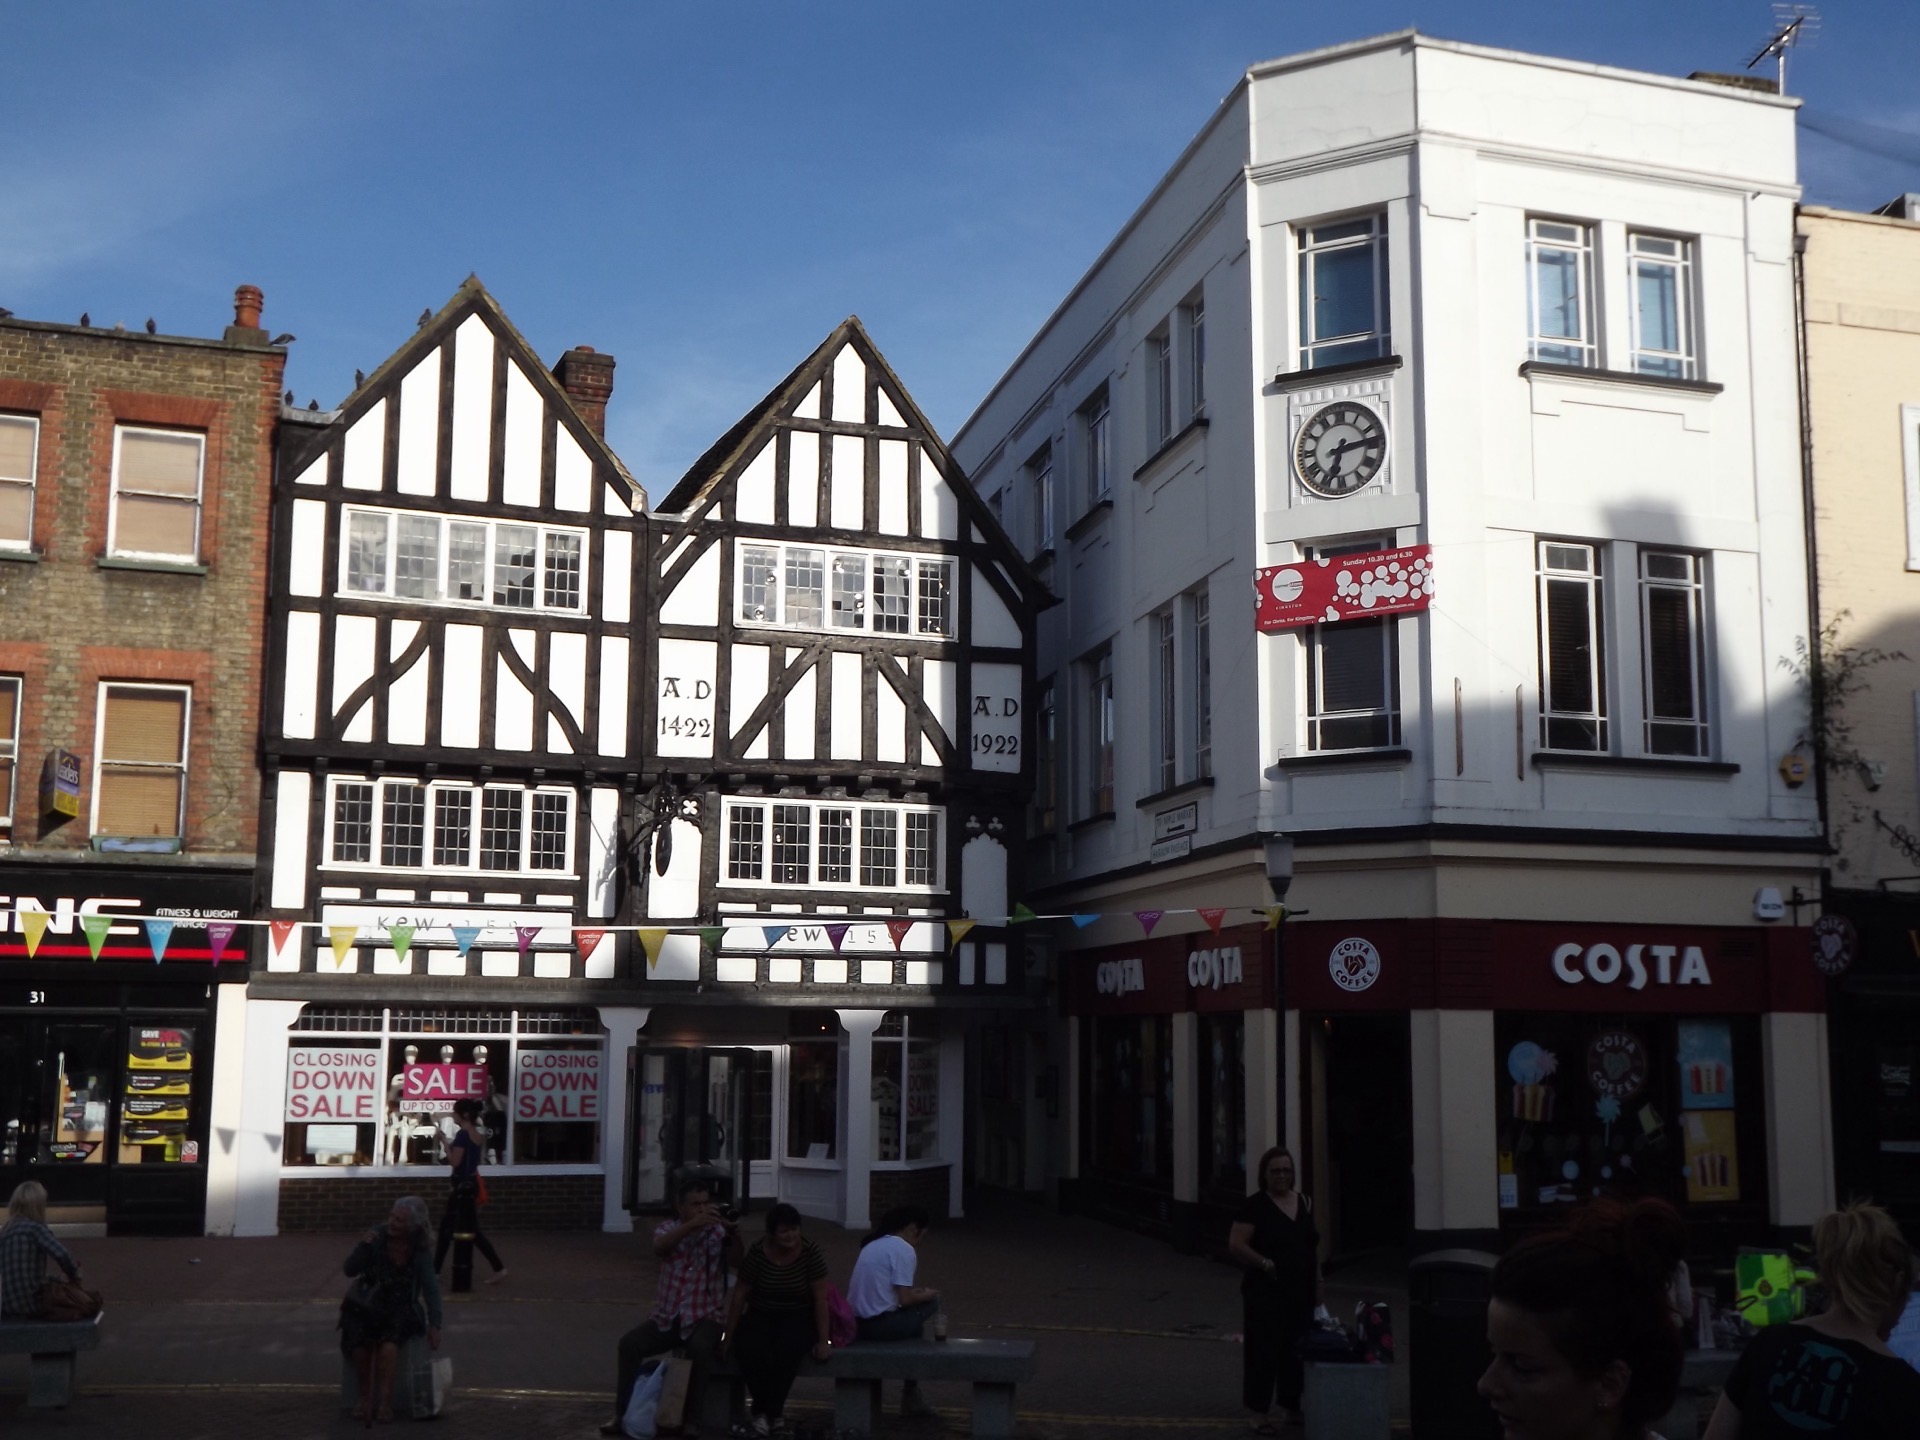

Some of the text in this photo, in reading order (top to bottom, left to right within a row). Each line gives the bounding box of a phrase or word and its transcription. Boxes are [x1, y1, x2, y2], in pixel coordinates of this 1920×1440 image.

[660, 715, 711, 738] 1422
[972, 733, 1018, 755] 1922
[0, 896, 141, 935] NC
[156, 908, 239, 919] FITNESS & WEIGHT
[1815, 918, 1845, 936] COSTA
[1338, 942, 1370, 956] COSTA
[1188, 946, 1243, 991] COSTA
[1551, 942, 1713, 991] COSTA
[1814, 951, 1850, 971] COFFEE
[1096, 958, 1145, 997] COSTA
[1336, 970, 1374, 987] COFFEE
[29, 990, 45, 1004] 31
[141, 1030, 160, 1039] SAVE
[1595, 1034, 1636, 1054] COSTA
[294, 1053, 377, 1067] CLOSING
[521, 1055, 599, 1069] CLOSING
[293, 1071, 376, 1092] DOWN
[408, 1067, 484, 1095] SALE
[520, 1073, 598, 1093] DOWN
[908, 1073, 937, 1092] DOWN
[1592, 1070, 1641, 1095] COFFEE
[290, 1095, 374, 1118] SALE
[402, 1101, 416, 1111] UP
[420, 1101, 435, 1111] TO
[518, 1095, 597, 1118] SALE
[908, 1094, 937, 1116] SALE
